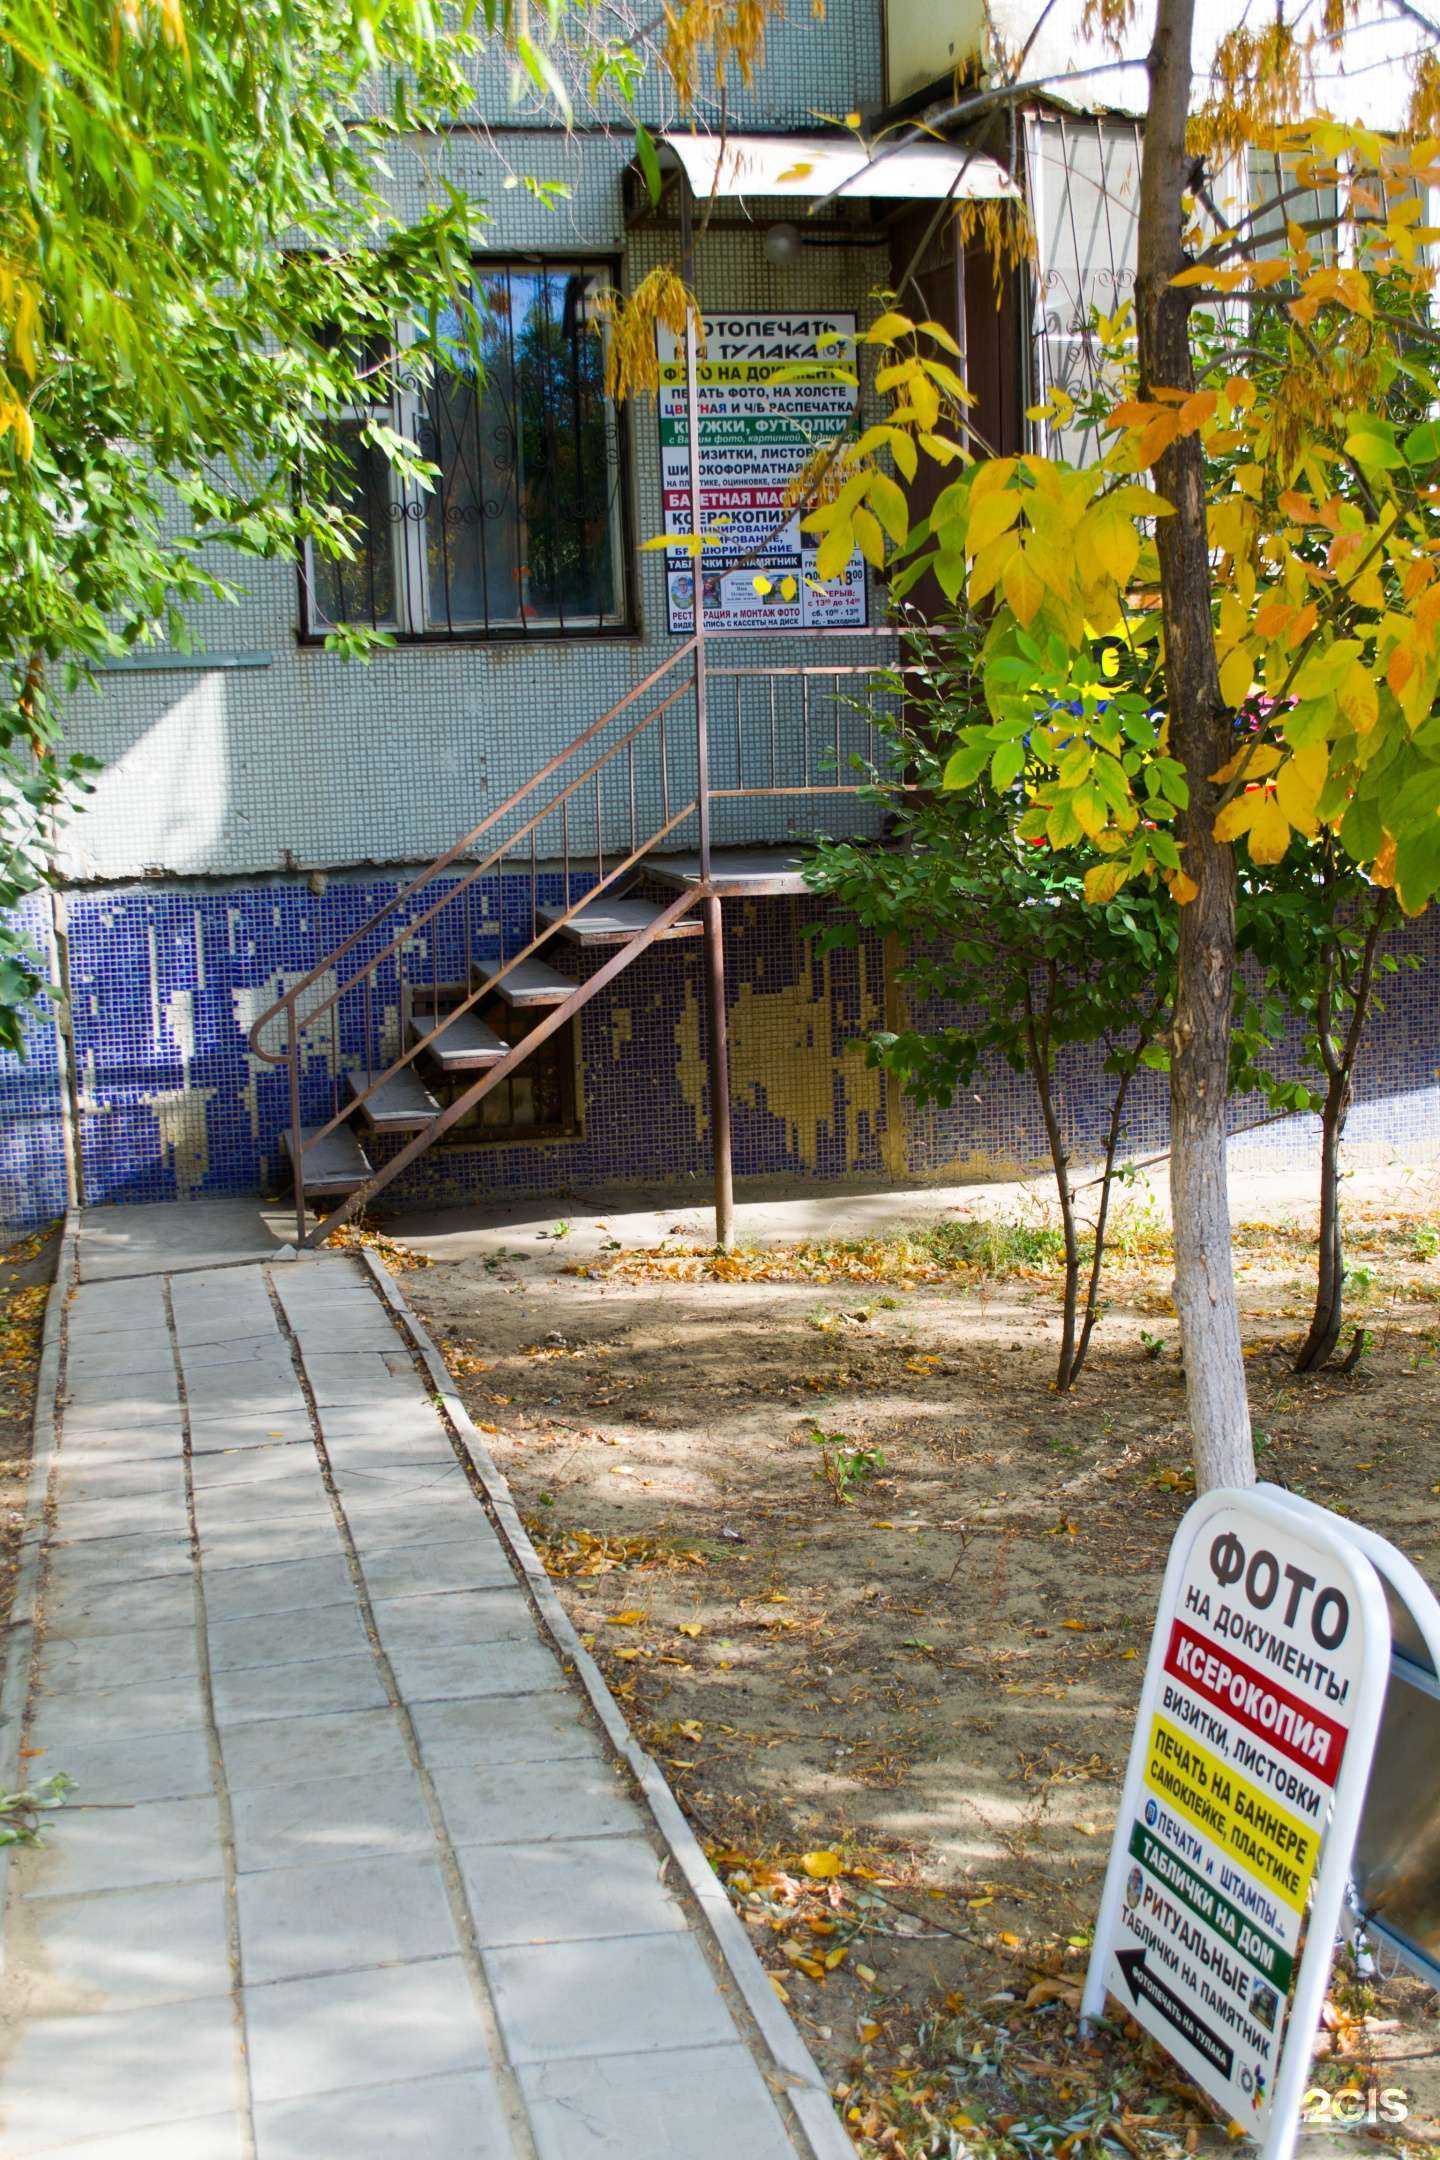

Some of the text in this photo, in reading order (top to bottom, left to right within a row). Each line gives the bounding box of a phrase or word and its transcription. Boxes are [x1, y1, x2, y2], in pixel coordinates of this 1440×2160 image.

[671, 386, 847, 399] ПЕАТЬ ФОТО, НА ХОЛСТЕ
[718, 366, 741, 380] НА
[719, 343, 819, 360] ТУЛАКА
[699, 449, 757, 461] ИЗИТКИ,
[731, 403, 741, 414] И
[744, 402, 765, 413] Ч/Б
[755, 418, 848, 433] ФУТБОЛКИ
[669, 492, 751, 507] БАЕТНАЯ
[733, 619, 766, 627] КАССЕТЫ
[780, 617, 799, 625] ДИСК
[739, 608, 775, 618] МОНТАЖ
[777, 608, 800, 617] ФОТО
[1209, 1532, 1349, 1650] ФОТО
[1185, 1585, 1349, 1706] НА ДОКУМЕНТЫ!
[1163, 1685, 1320, 1818] ВИЗИТКИ, ЛИСТОВКИ
[1176, 1637, 1331, 1767] КСЕРОКОПИЯ
[1150, 1760, 1300, 1895] САМОКЛЕЙКЕ, ПЛАСТИКЕ
[1154, 1728, 1308, 1865] ПЕЧАТЬ НА БАННЕРЕ
[1144, 1837, 1275, 1971] ТАБЛИЧКИ НА ДОМ
[1157, 1811, 1276, 1930] ПЕЧАТИ и ШТАМПЫ
[1121, 1904, 1270, 2060] ТАБЛИЧКИ НА ПАМЯТНИК
[1143, 1884, 1249, 2000] РИТУАЛЬНЫЕ
[1131, 1966, 1227, 2066] ФОТОПЕЧАТЬ НА ТУЛАКА
